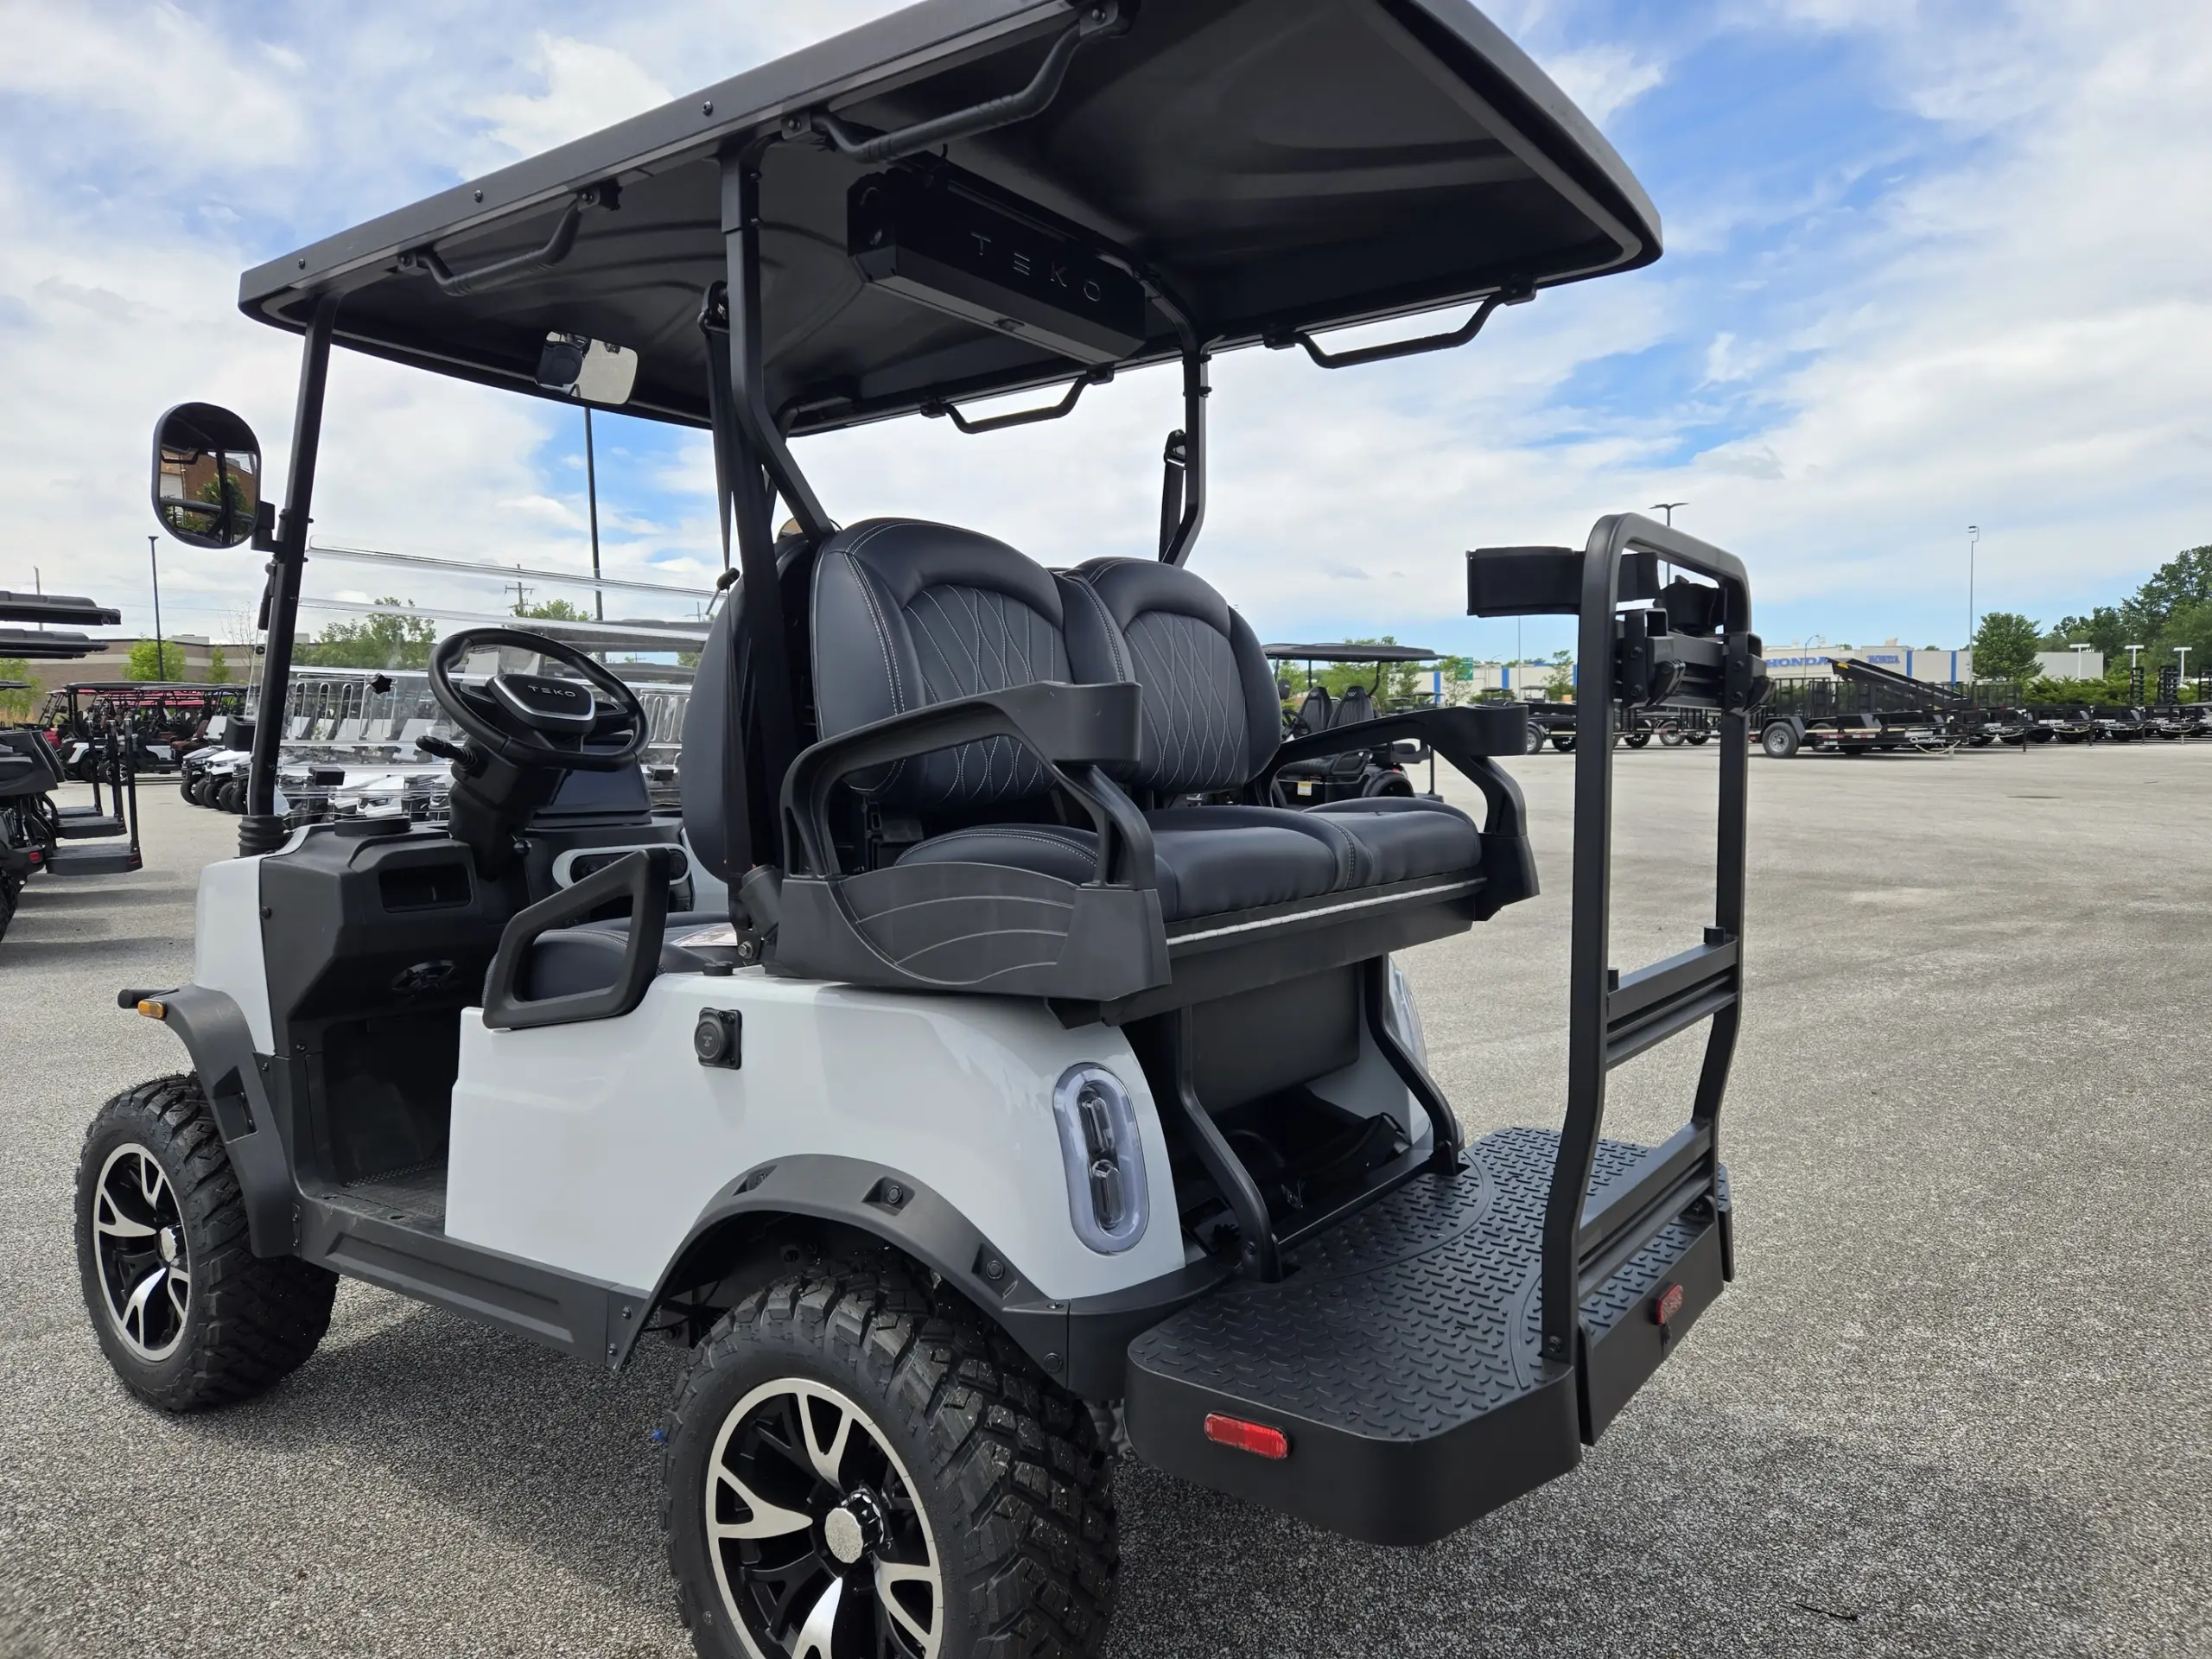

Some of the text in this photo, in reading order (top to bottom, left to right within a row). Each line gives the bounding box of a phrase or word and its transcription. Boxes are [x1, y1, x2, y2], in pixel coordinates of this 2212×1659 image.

[970, 231, 1102, 302] TEKO
[1765, 656, 1831, 668] HONDA
[527, 685, 576, 697] TEKO
